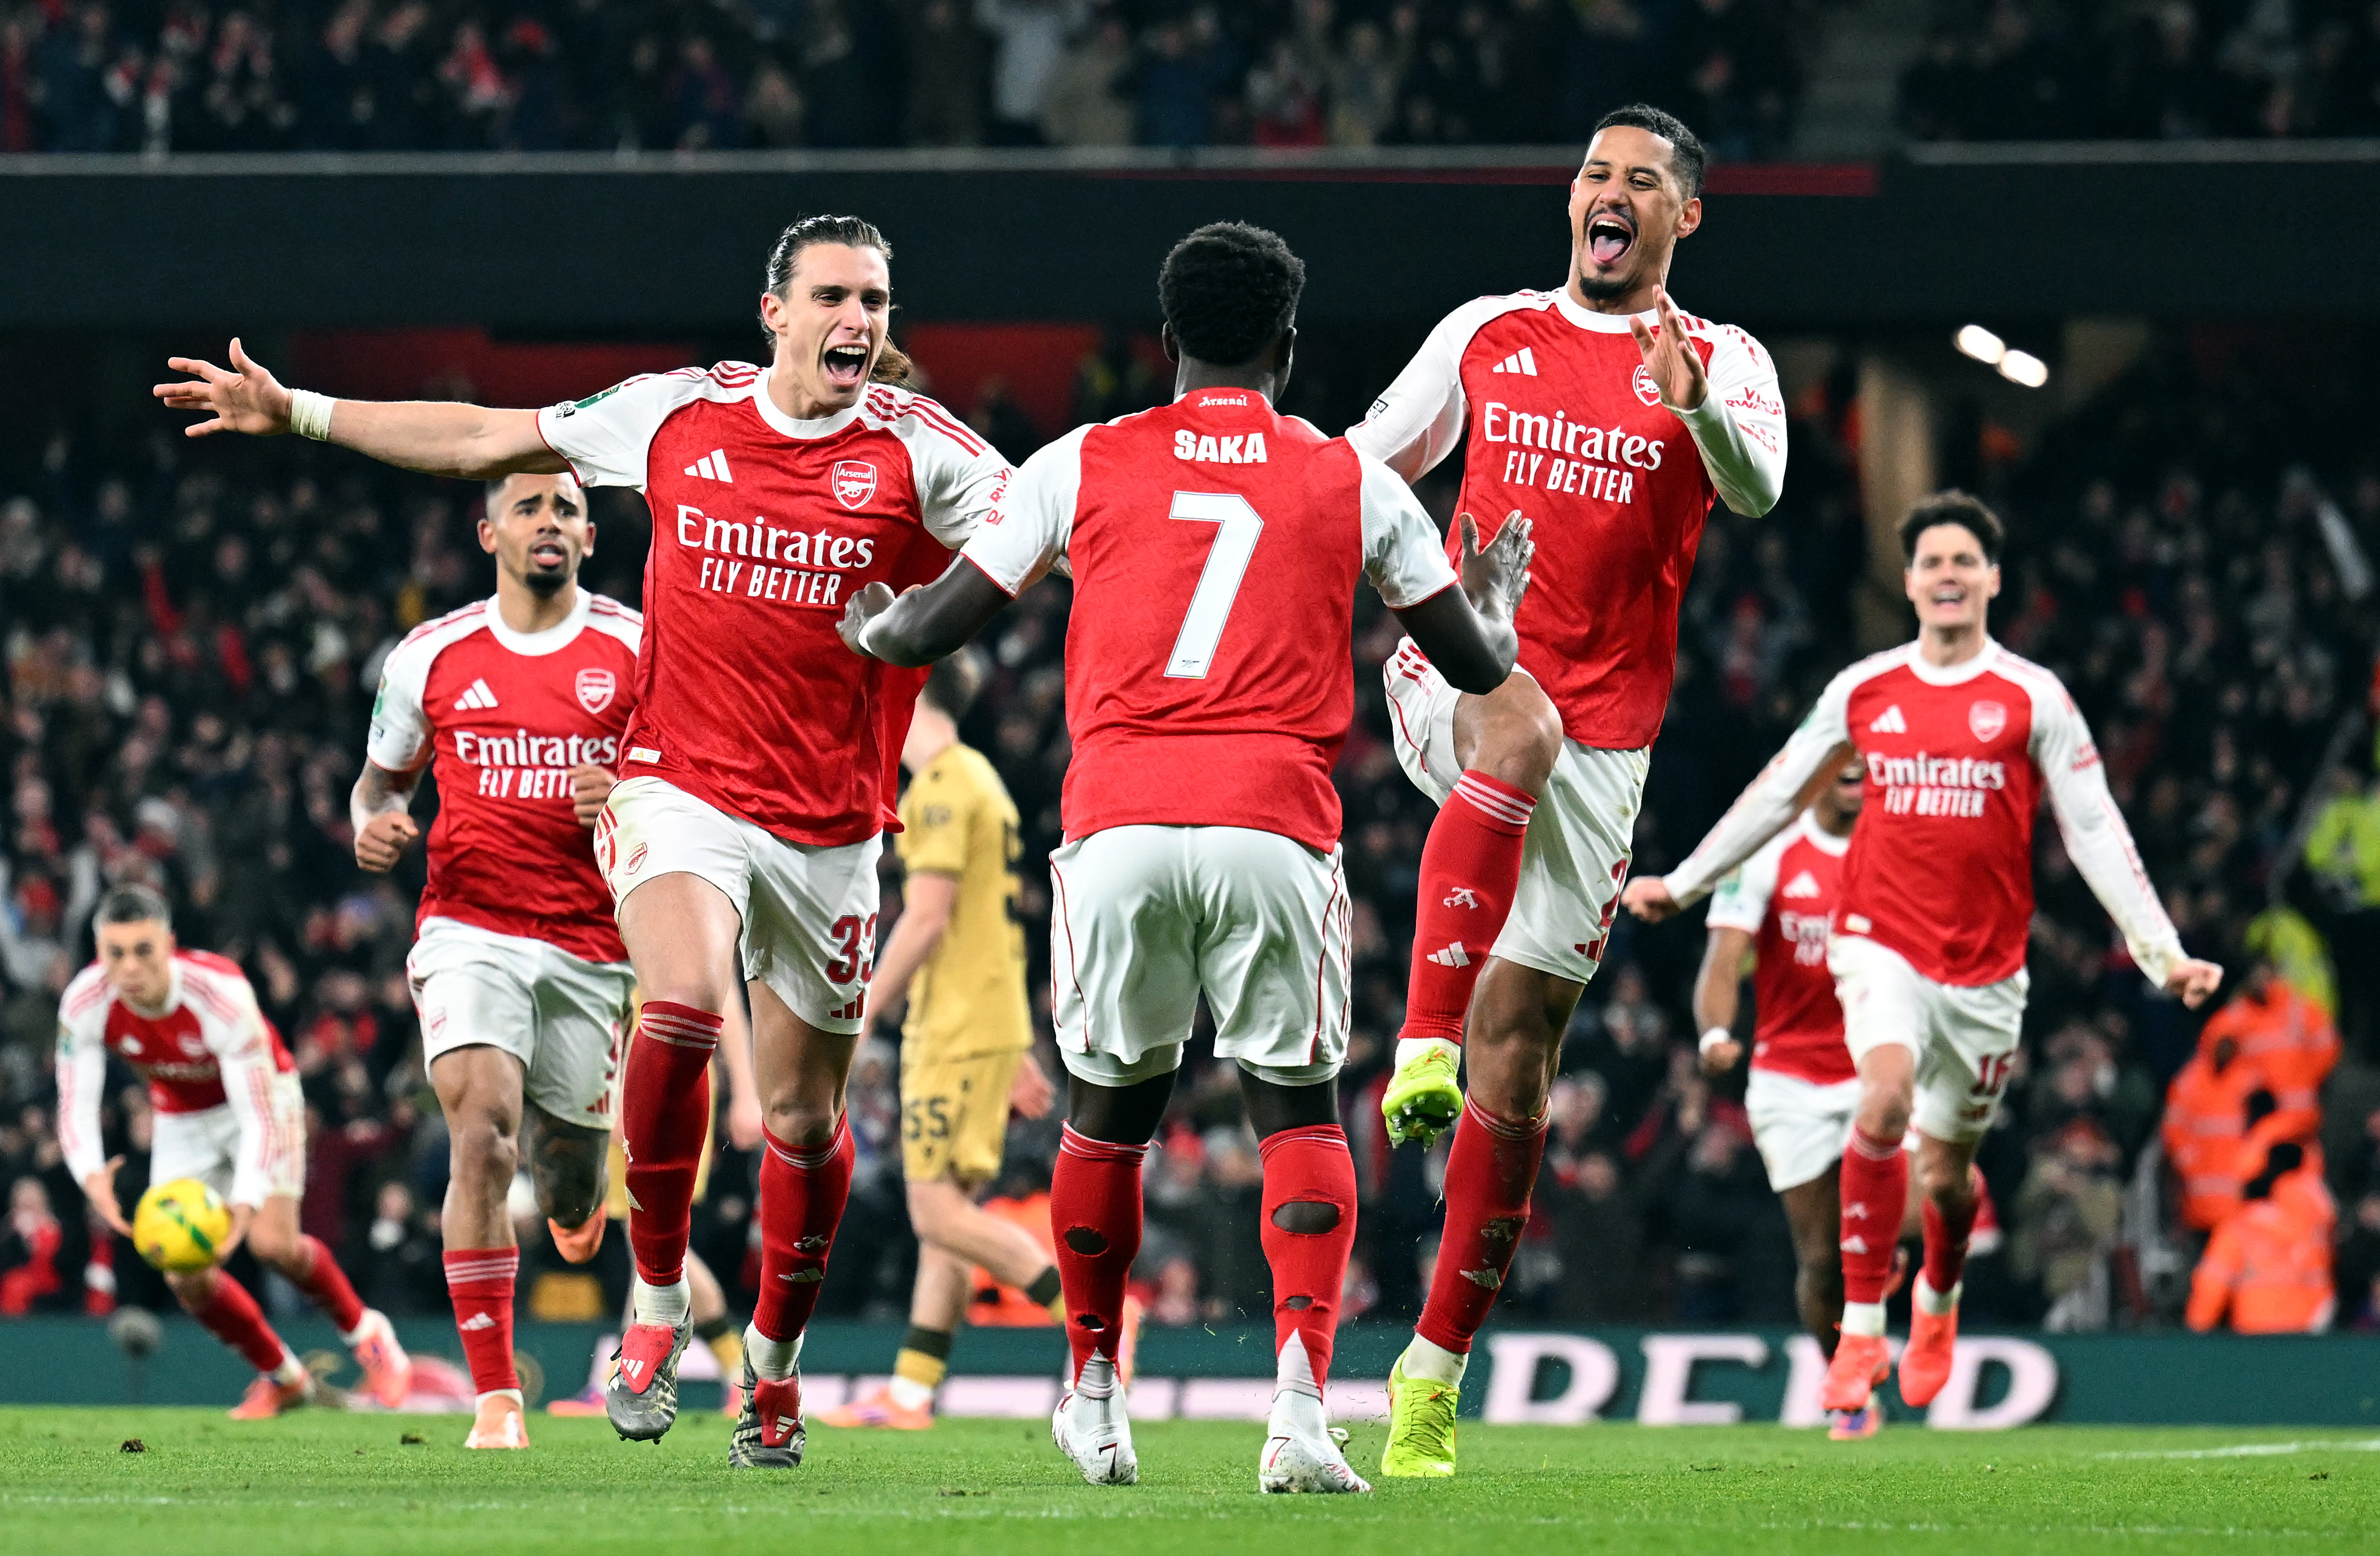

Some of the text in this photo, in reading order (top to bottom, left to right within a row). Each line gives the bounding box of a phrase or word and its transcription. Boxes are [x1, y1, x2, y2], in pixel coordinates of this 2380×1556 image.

[1199, 394, 1247, 407] Arsenal
[1174, 429, 1267, 463] SAKA
[1484, 402, 1664, 471] Emirates
[839, 468, 870, 479] Arsenal
[1503, 451, 1633, 504] FLY BETTER
[677, 504, 874, 568] Emirates
[700, 557, 841, 605] FLY BETTER
[1164, 490, 1264, 679] 7
[453, 728, 617, 766] Emirates
[478, 768, 576, 799] FLY BETT
[1866, 750, 2005, 790] Emirates
[1098, 1442, 1118, 1478] 7
[1269, 1437, 1291, 1468] 7
